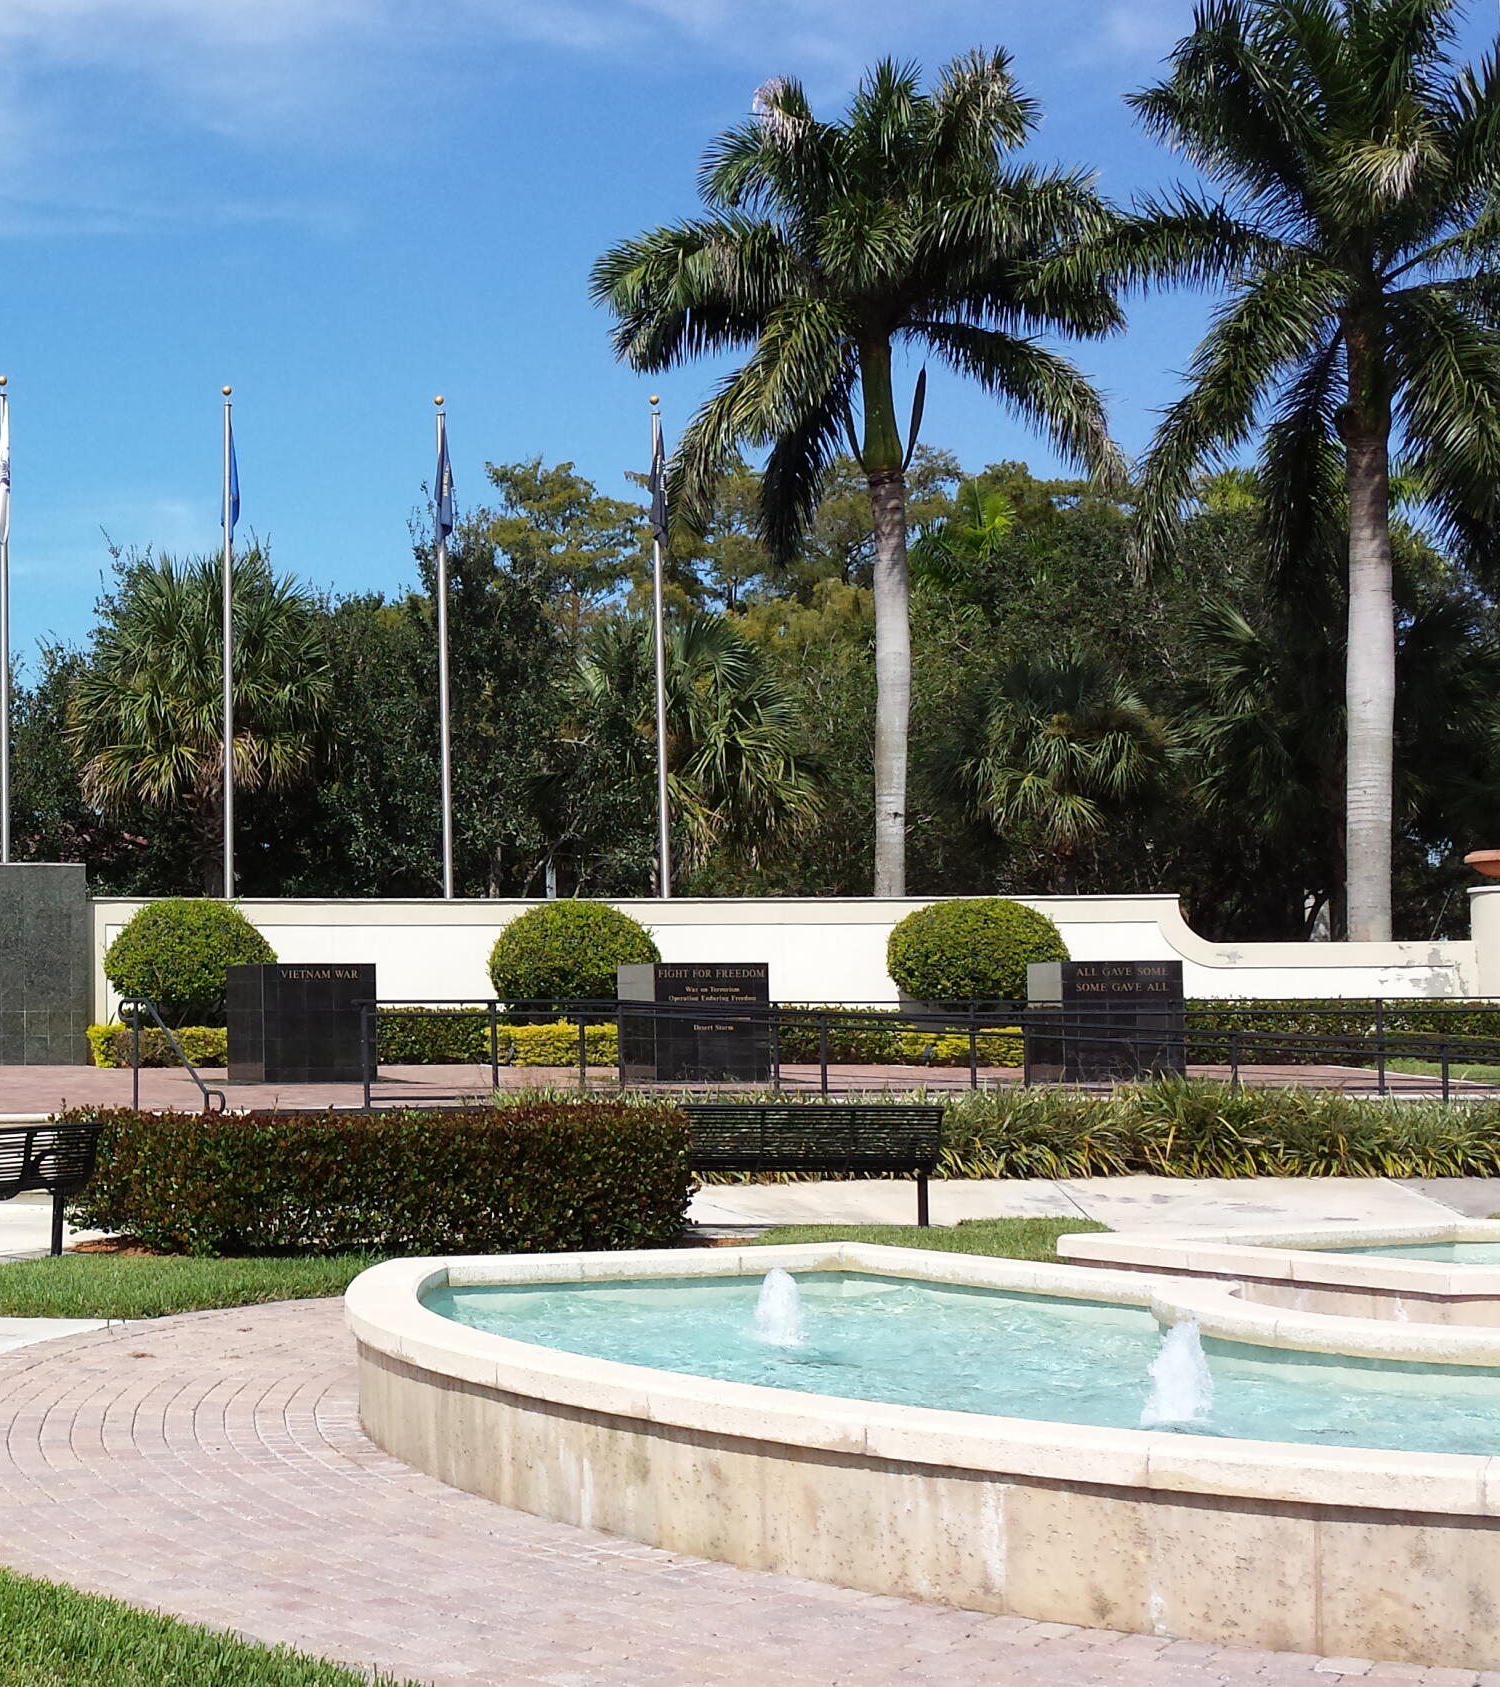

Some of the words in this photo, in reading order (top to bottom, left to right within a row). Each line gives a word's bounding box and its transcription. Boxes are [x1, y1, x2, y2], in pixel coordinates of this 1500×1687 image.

[281, 969, 331, 979] VIETNAM
[334, 969, 359, 979] WAR
[658, 969, 689, 979] FIGHT
[692, 969, 712, 979] FOR
[715, 969, 765, 979] FREEDOM
[1076, 967, 1098, 977] ALL
[1102, 967, 1133, 977] GAVE
[1137, 967, 1169, 977] SOME
[1075, 982, 1108, 992] SOME
[1111, 982, 1143, 992] GAVE
[1146, 982, 1169, 992] ALL
